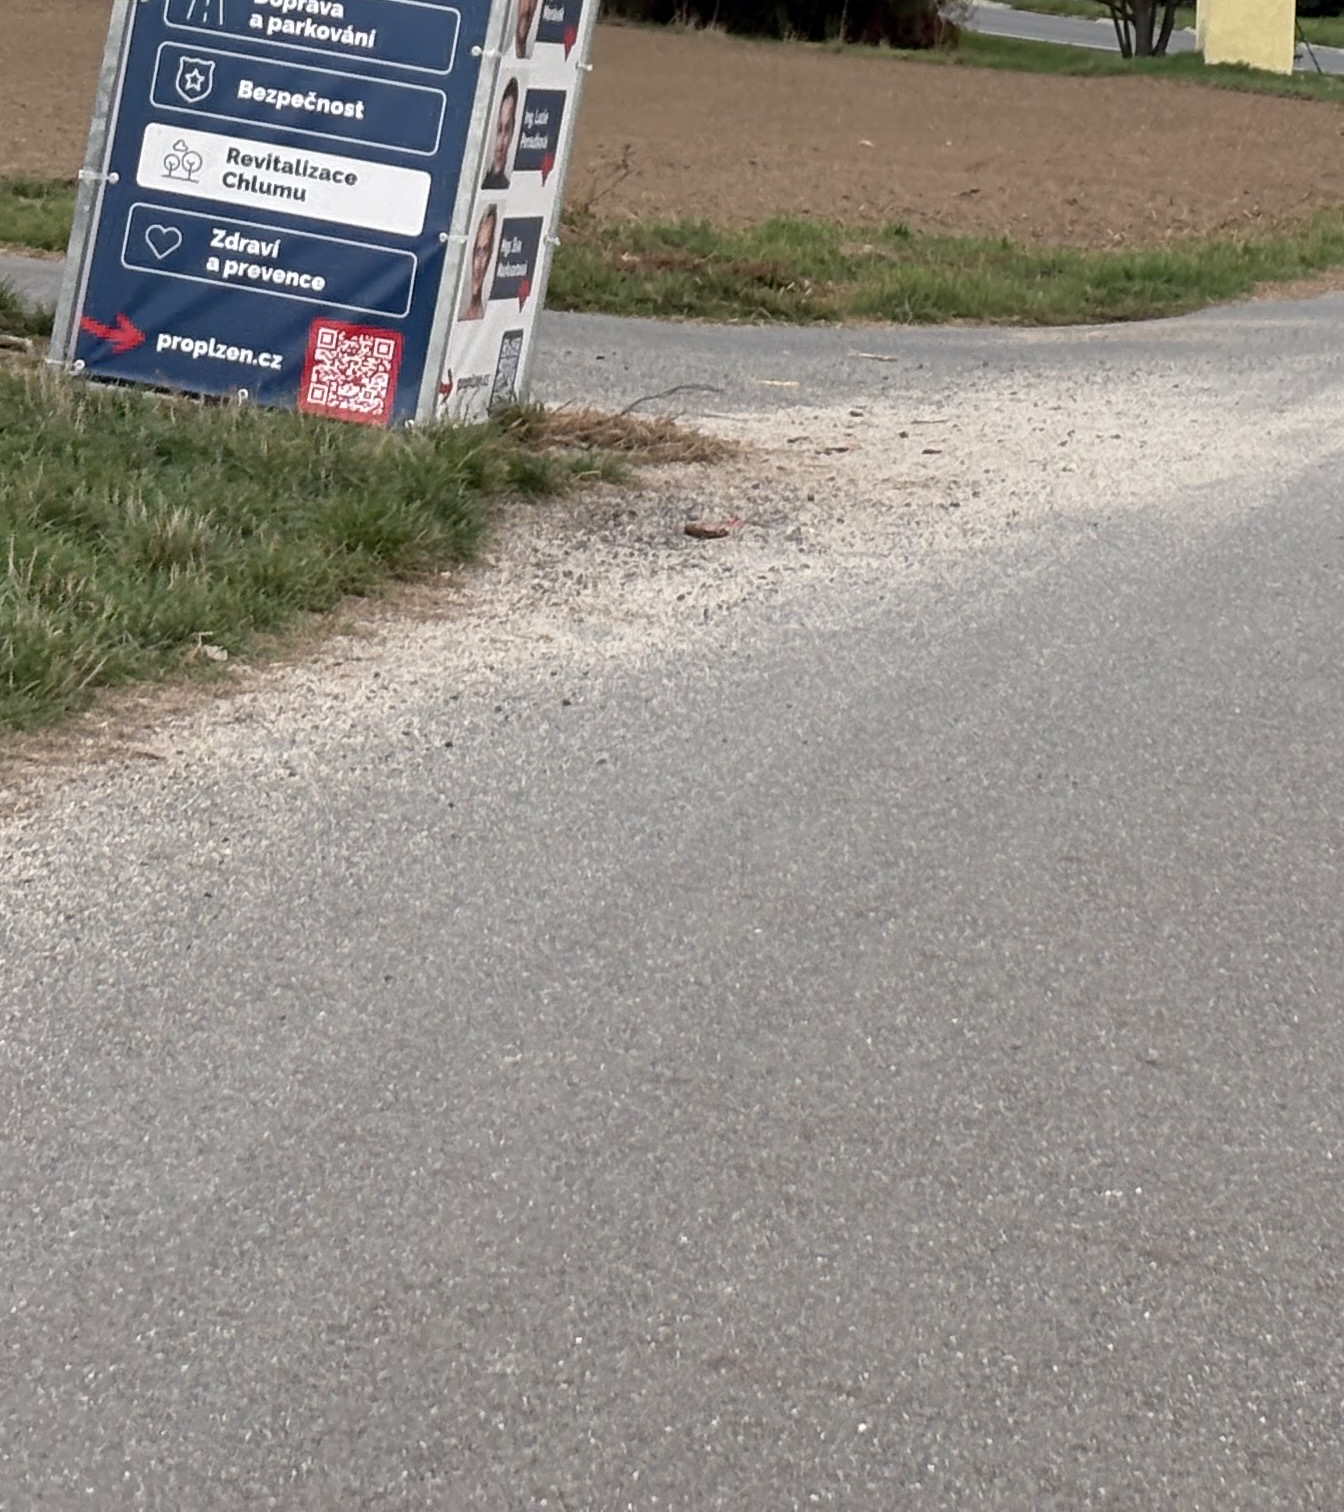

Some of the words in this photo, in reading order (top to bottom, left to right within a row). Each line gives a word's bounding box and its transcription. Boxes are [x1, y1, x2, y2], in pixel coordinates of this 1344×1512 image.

[249, 13, 264, 29] a
[266, 16, 377, 48] parkování
[237, 79, 365, 120] Bezpečnost
[226, 146, 359, 186] Revitalizace
[222, 171, 307, 202] Chlumu
[210, 228, 281, 258] Zdraví
[206, 256, 220, 272] a
[222, 259, 326, 291] prevence
[156, 333, 284, 370] proplzen.cz
